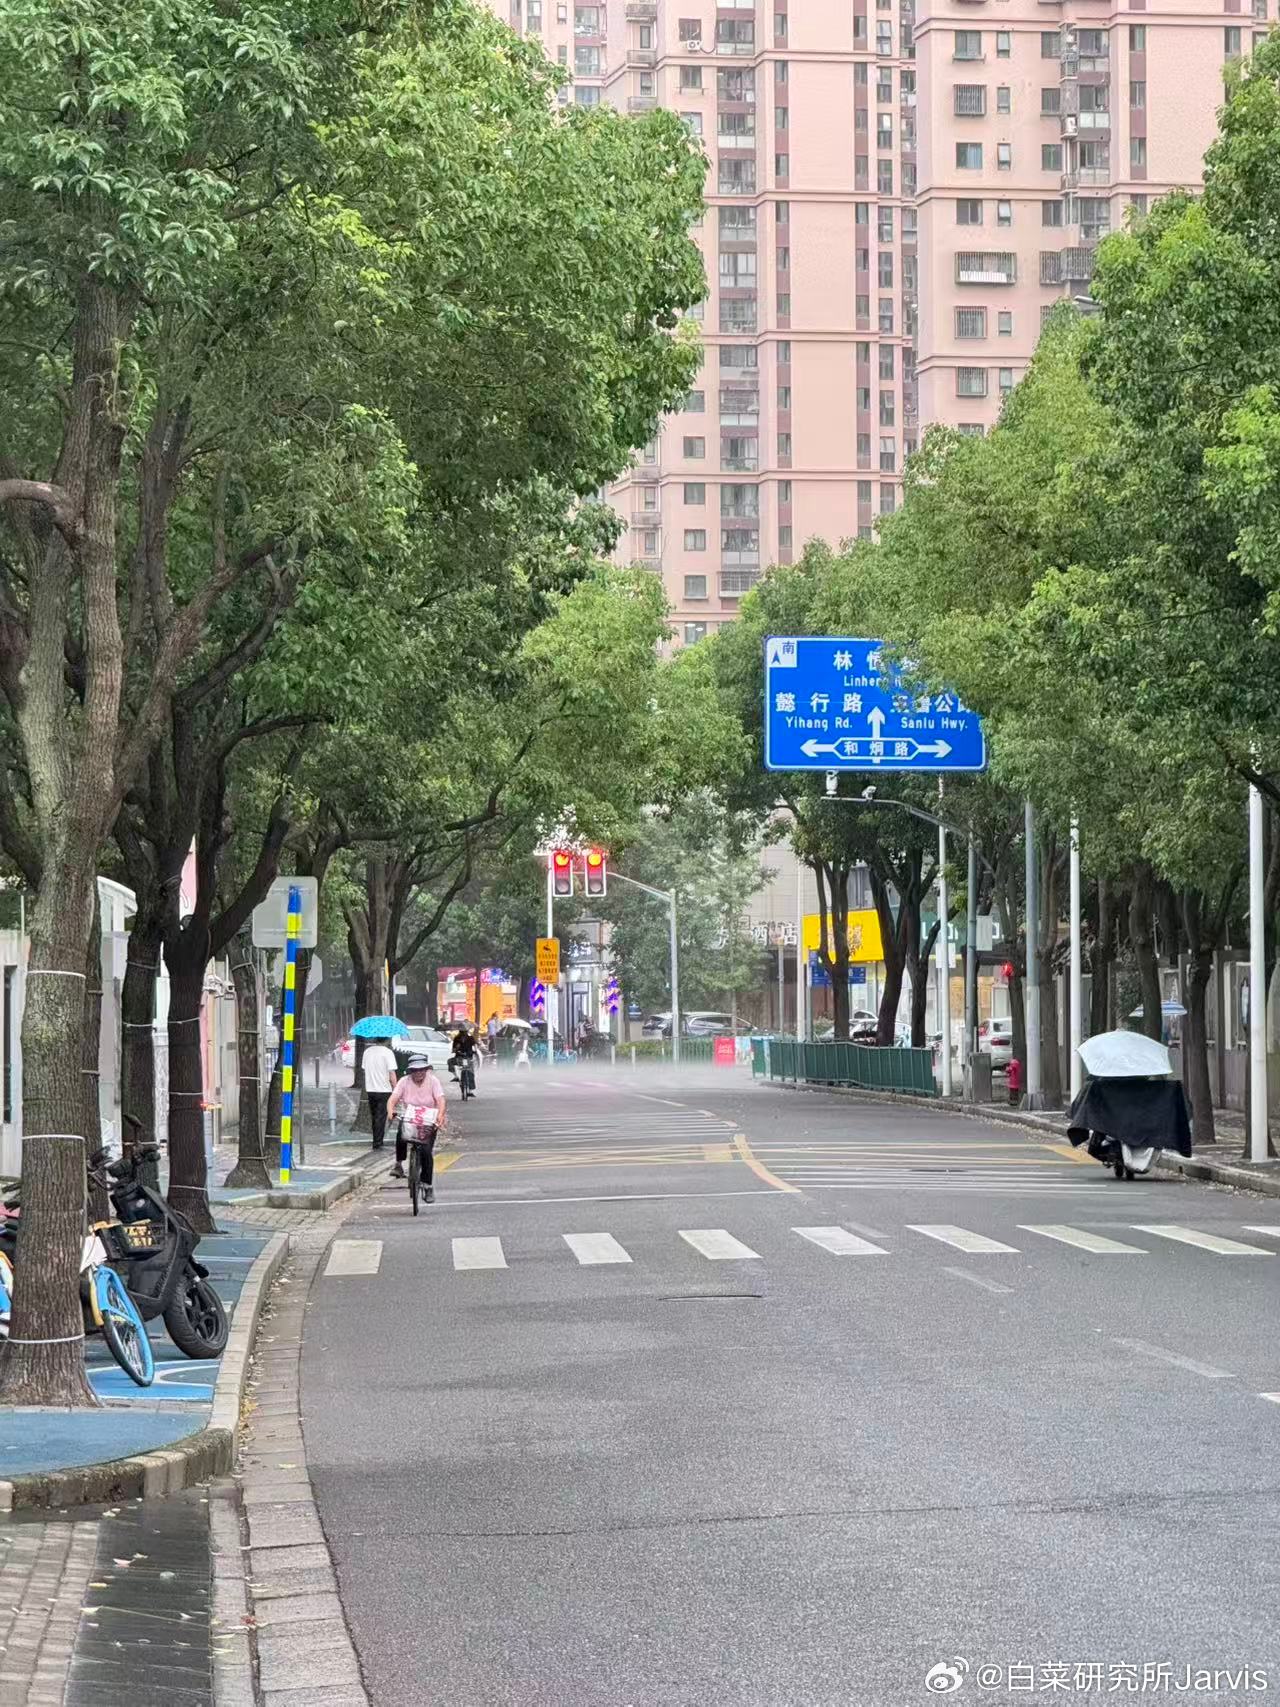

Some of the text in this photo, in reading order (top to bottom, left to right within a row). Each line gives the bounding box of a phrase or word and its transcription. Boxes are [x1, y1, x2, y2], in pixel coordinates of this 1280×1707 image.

[782, 641, 795, 655] 南
[775, 692, 862, 713] 懿行路
[785, 715, 853, 732] Yihang Rd.
[901, 716, 968, 731] Sanlu Hwy.
